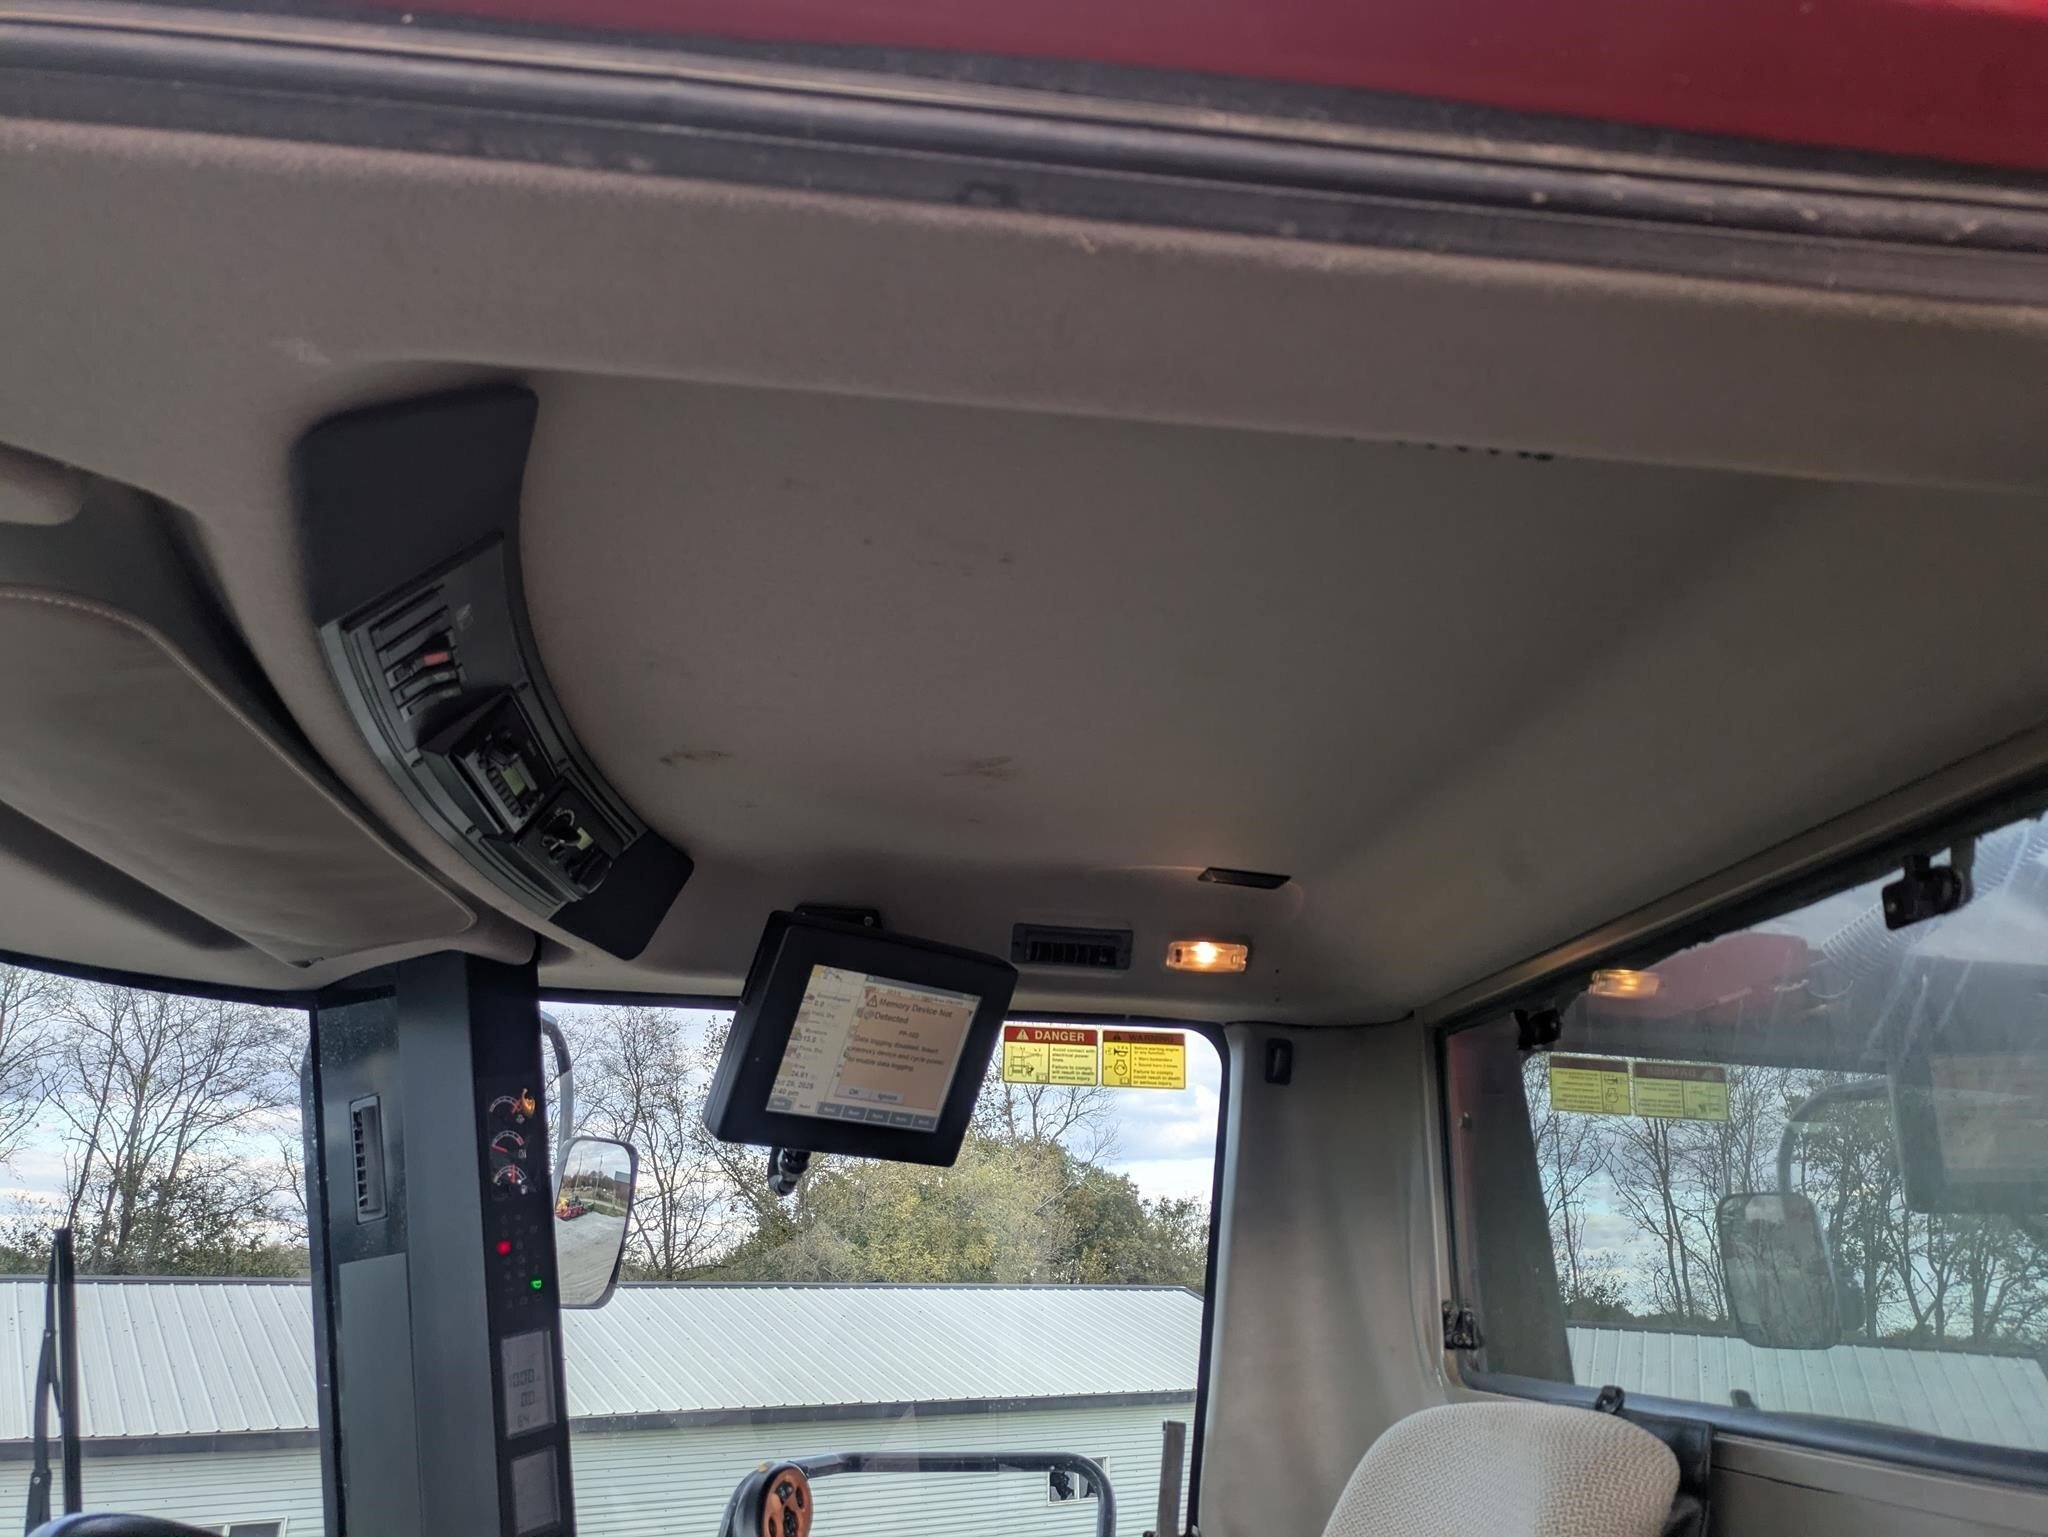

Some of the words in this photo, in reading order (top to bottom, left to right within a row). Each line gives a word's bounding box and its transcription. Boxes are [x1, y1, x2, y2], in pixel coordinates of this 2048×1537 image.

[879, 998, 911, 1012] Memory
[912, 1004, 938, 1015] Device
[938, 1008, 953, 1018] Not
[874, 1011, 909, 1024] Detected
[1034, 1029, 1086, 1043] DANGER
